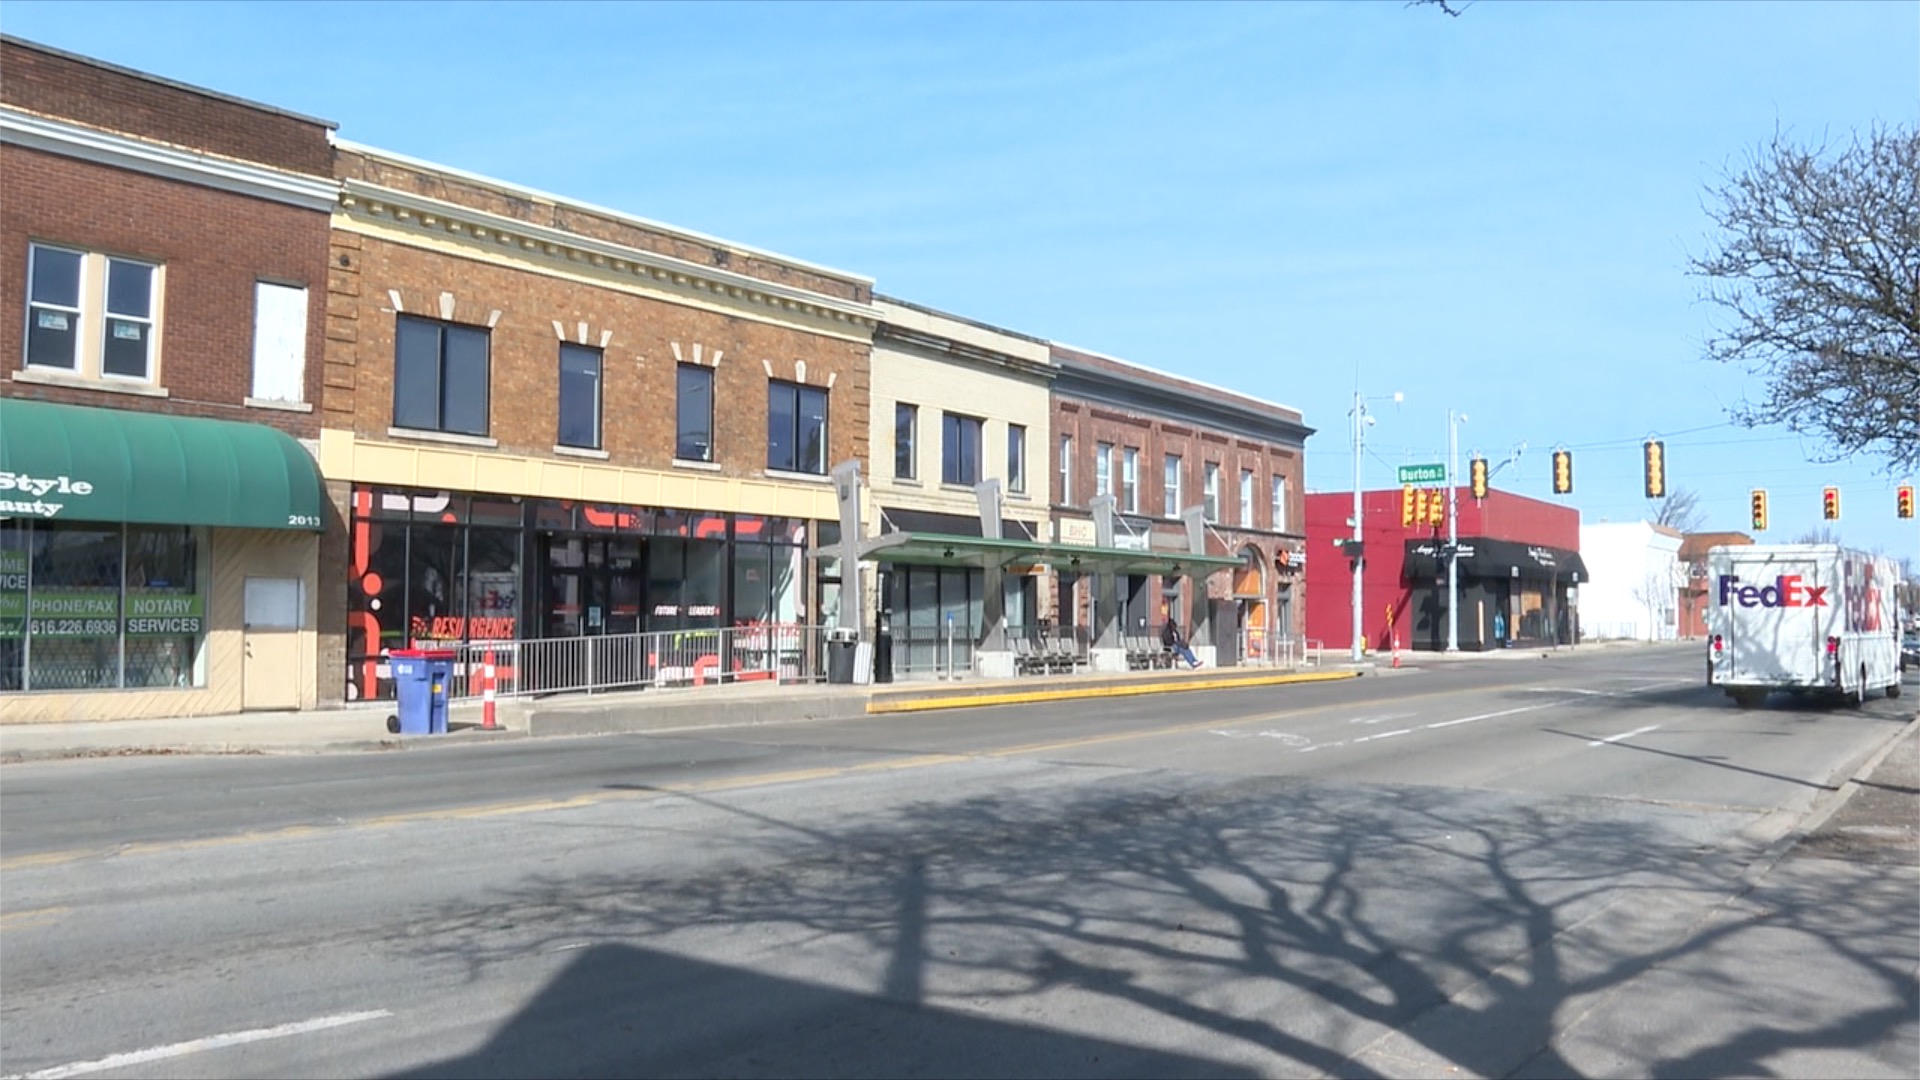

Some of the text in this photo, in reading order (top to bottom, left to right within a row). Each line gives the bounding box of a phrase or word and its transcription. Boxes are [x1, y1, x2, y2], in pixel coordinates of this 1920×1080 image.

[1400, 468, 1436, 481] Burton
[0, 471, 93, 496] Style
[288, 515, 321, 527] 2013
[1719, 575, 1828, 608] FedEx
[31, 599, 114, 612] PHONE/FAX
[134, 599, 192, 614] NOTARY
[688, 605, 716, 617] LEADERS
[31, 619, 117, 636] 616.226.6936
[128, 618, 199, 633] SERVICES
[432, 617, 516, 639] RESURGENCE
